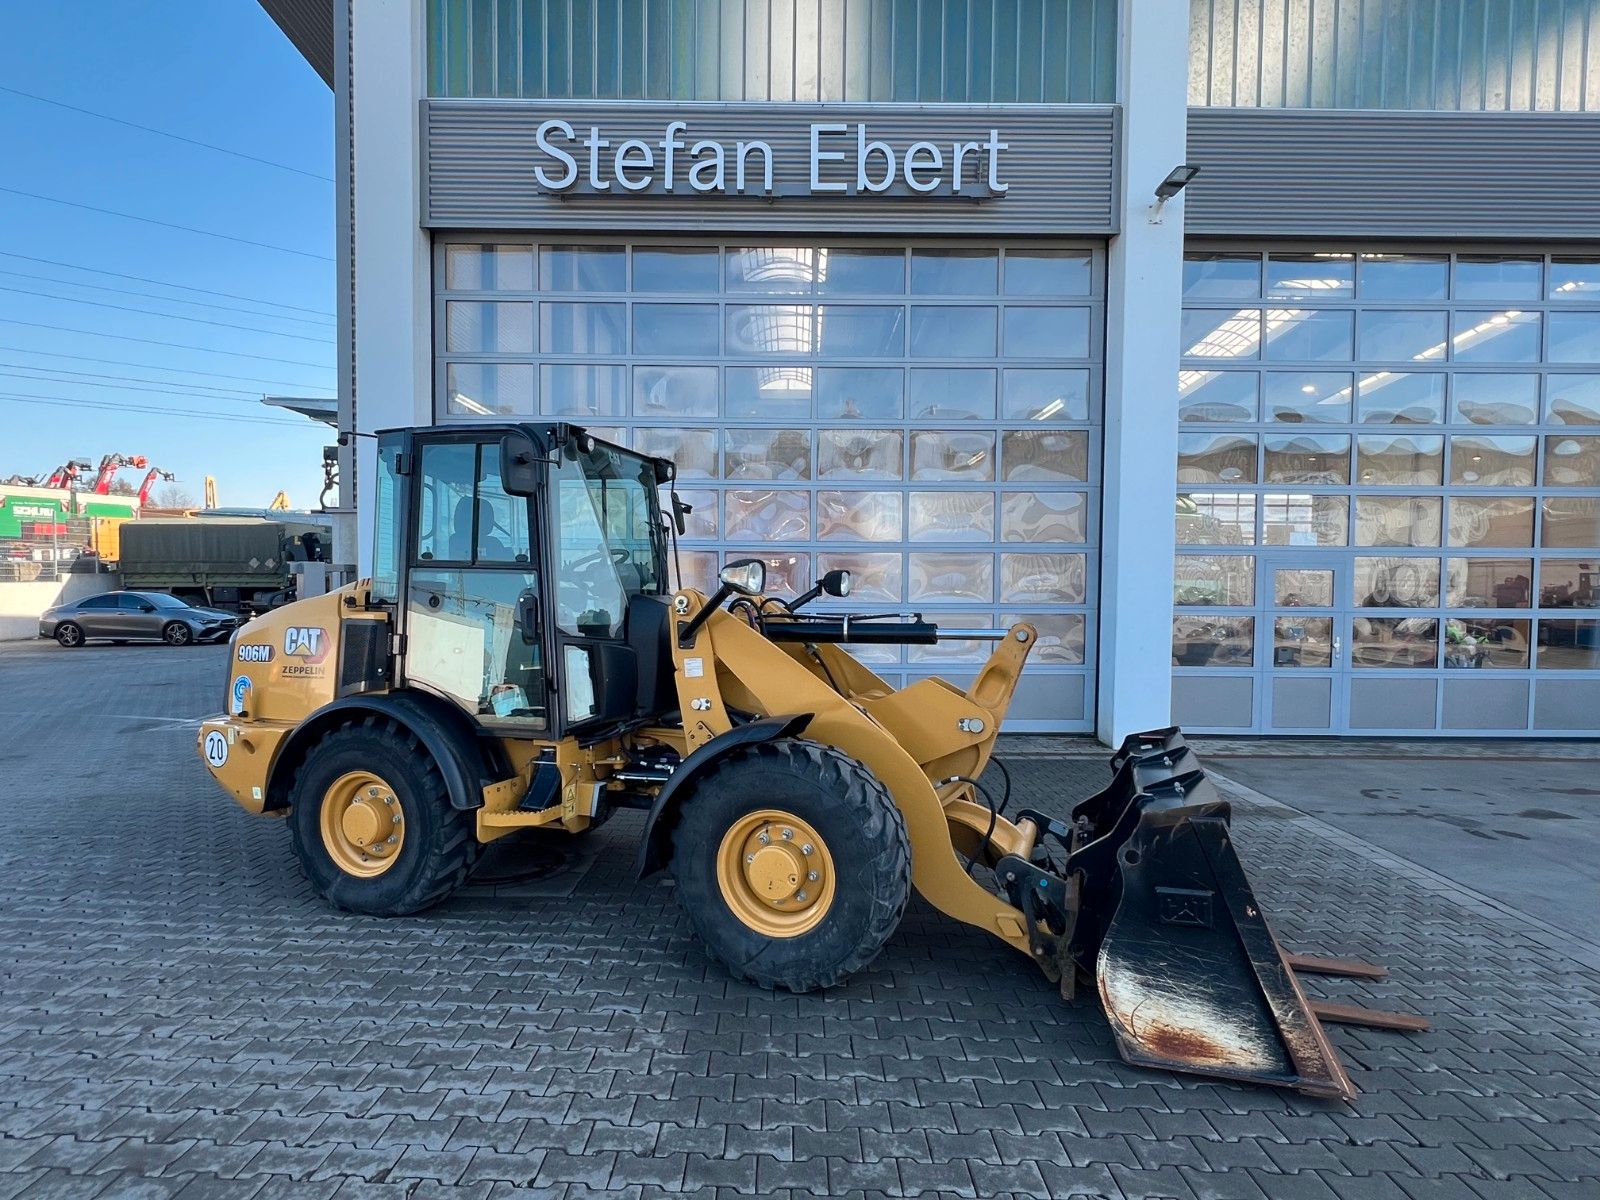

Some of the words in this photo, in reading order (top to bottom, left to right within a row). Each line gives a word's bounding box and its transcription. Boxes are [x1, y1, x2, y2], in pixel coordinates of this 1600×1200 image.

[534, 120, 774, 193] Stefan
[810, 123, 1009, 193] Ebert
[285, 627, 321, 656] CAT
[238, 645, 270, 662] 906M
[282, 665, 325, 675] ZEPPELIN
[209, 737, 224, 760] 20
